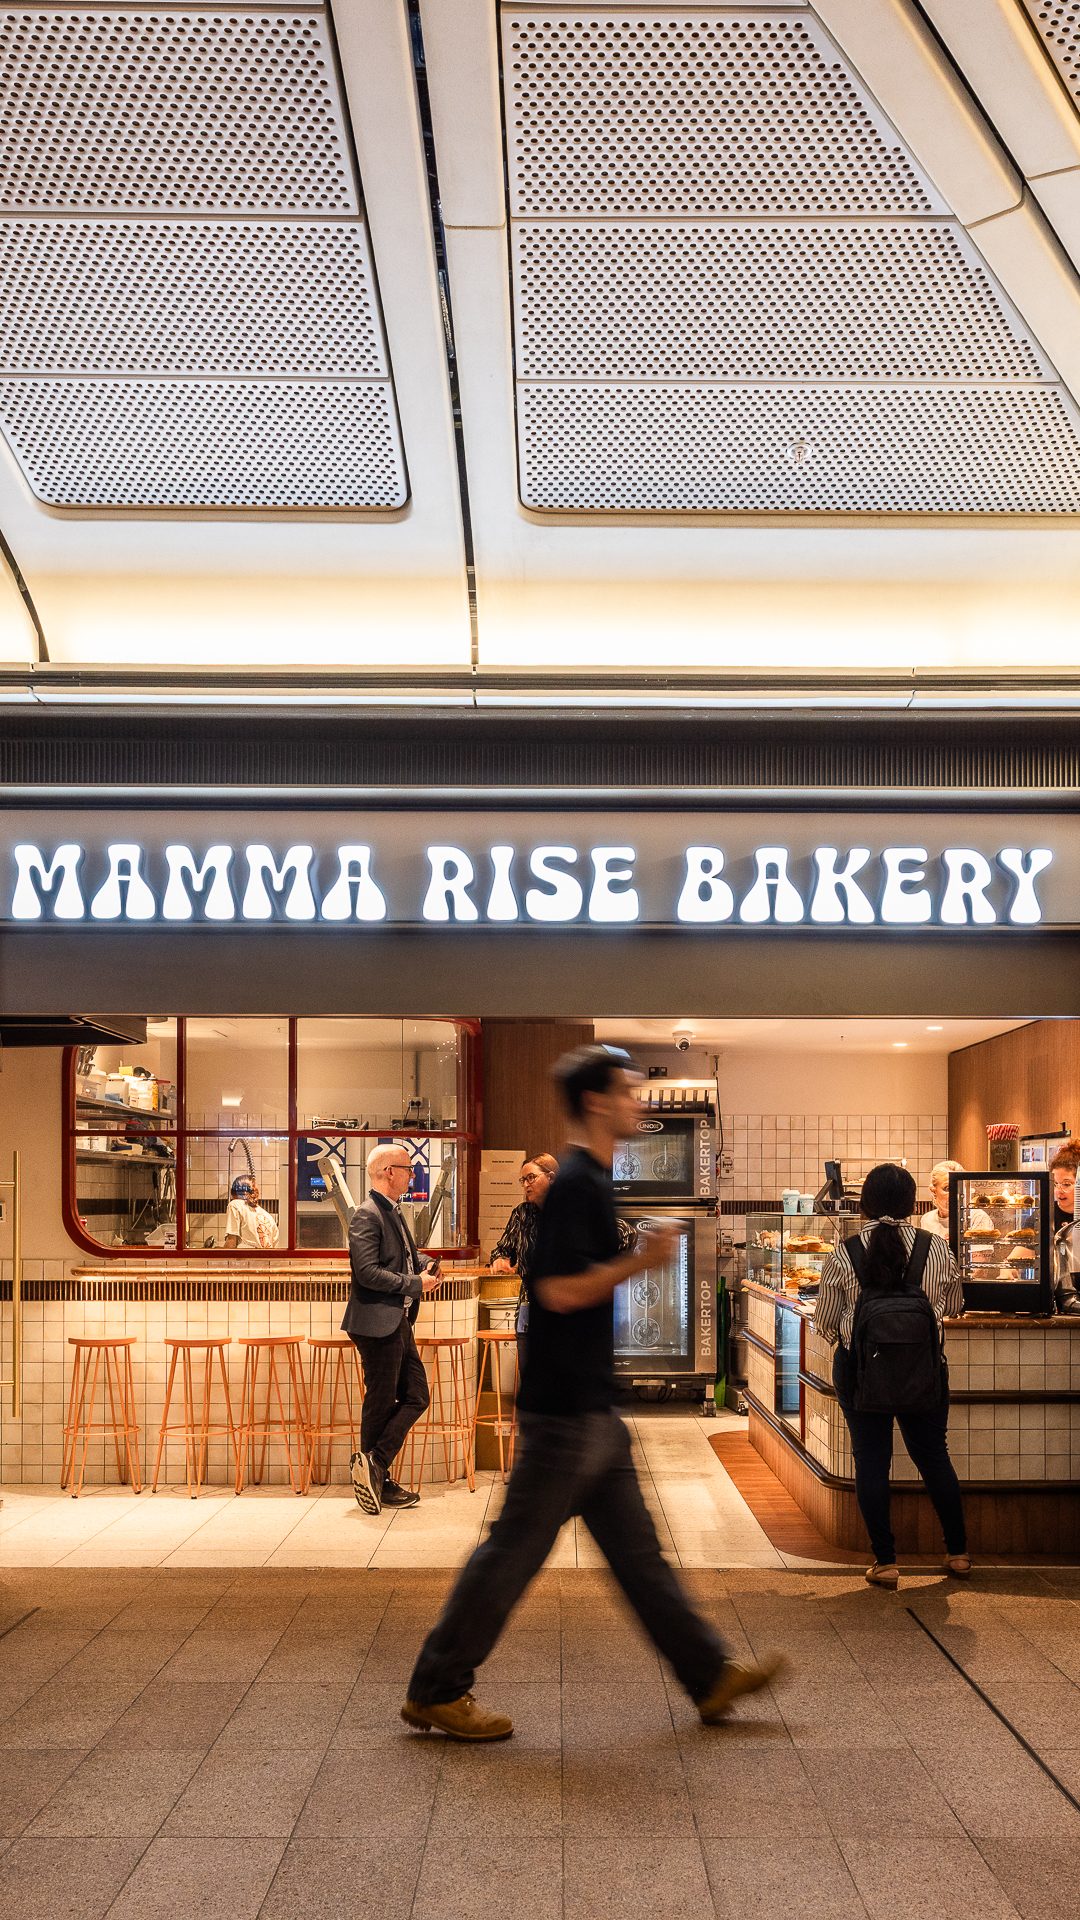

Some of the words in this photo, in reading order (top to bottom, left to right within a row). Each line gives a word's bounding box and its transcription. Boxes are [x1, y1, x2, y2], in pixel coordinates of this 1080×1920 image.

[11, 844, 387, 920] MAMMA
[422, 845, 639, 922] RISE
[677, 847, 1053, 924] BAKERY
[700, 1119, 711, 1196] BAKERTOP
[700, 1280, 712, 1357] BAKERTOP
